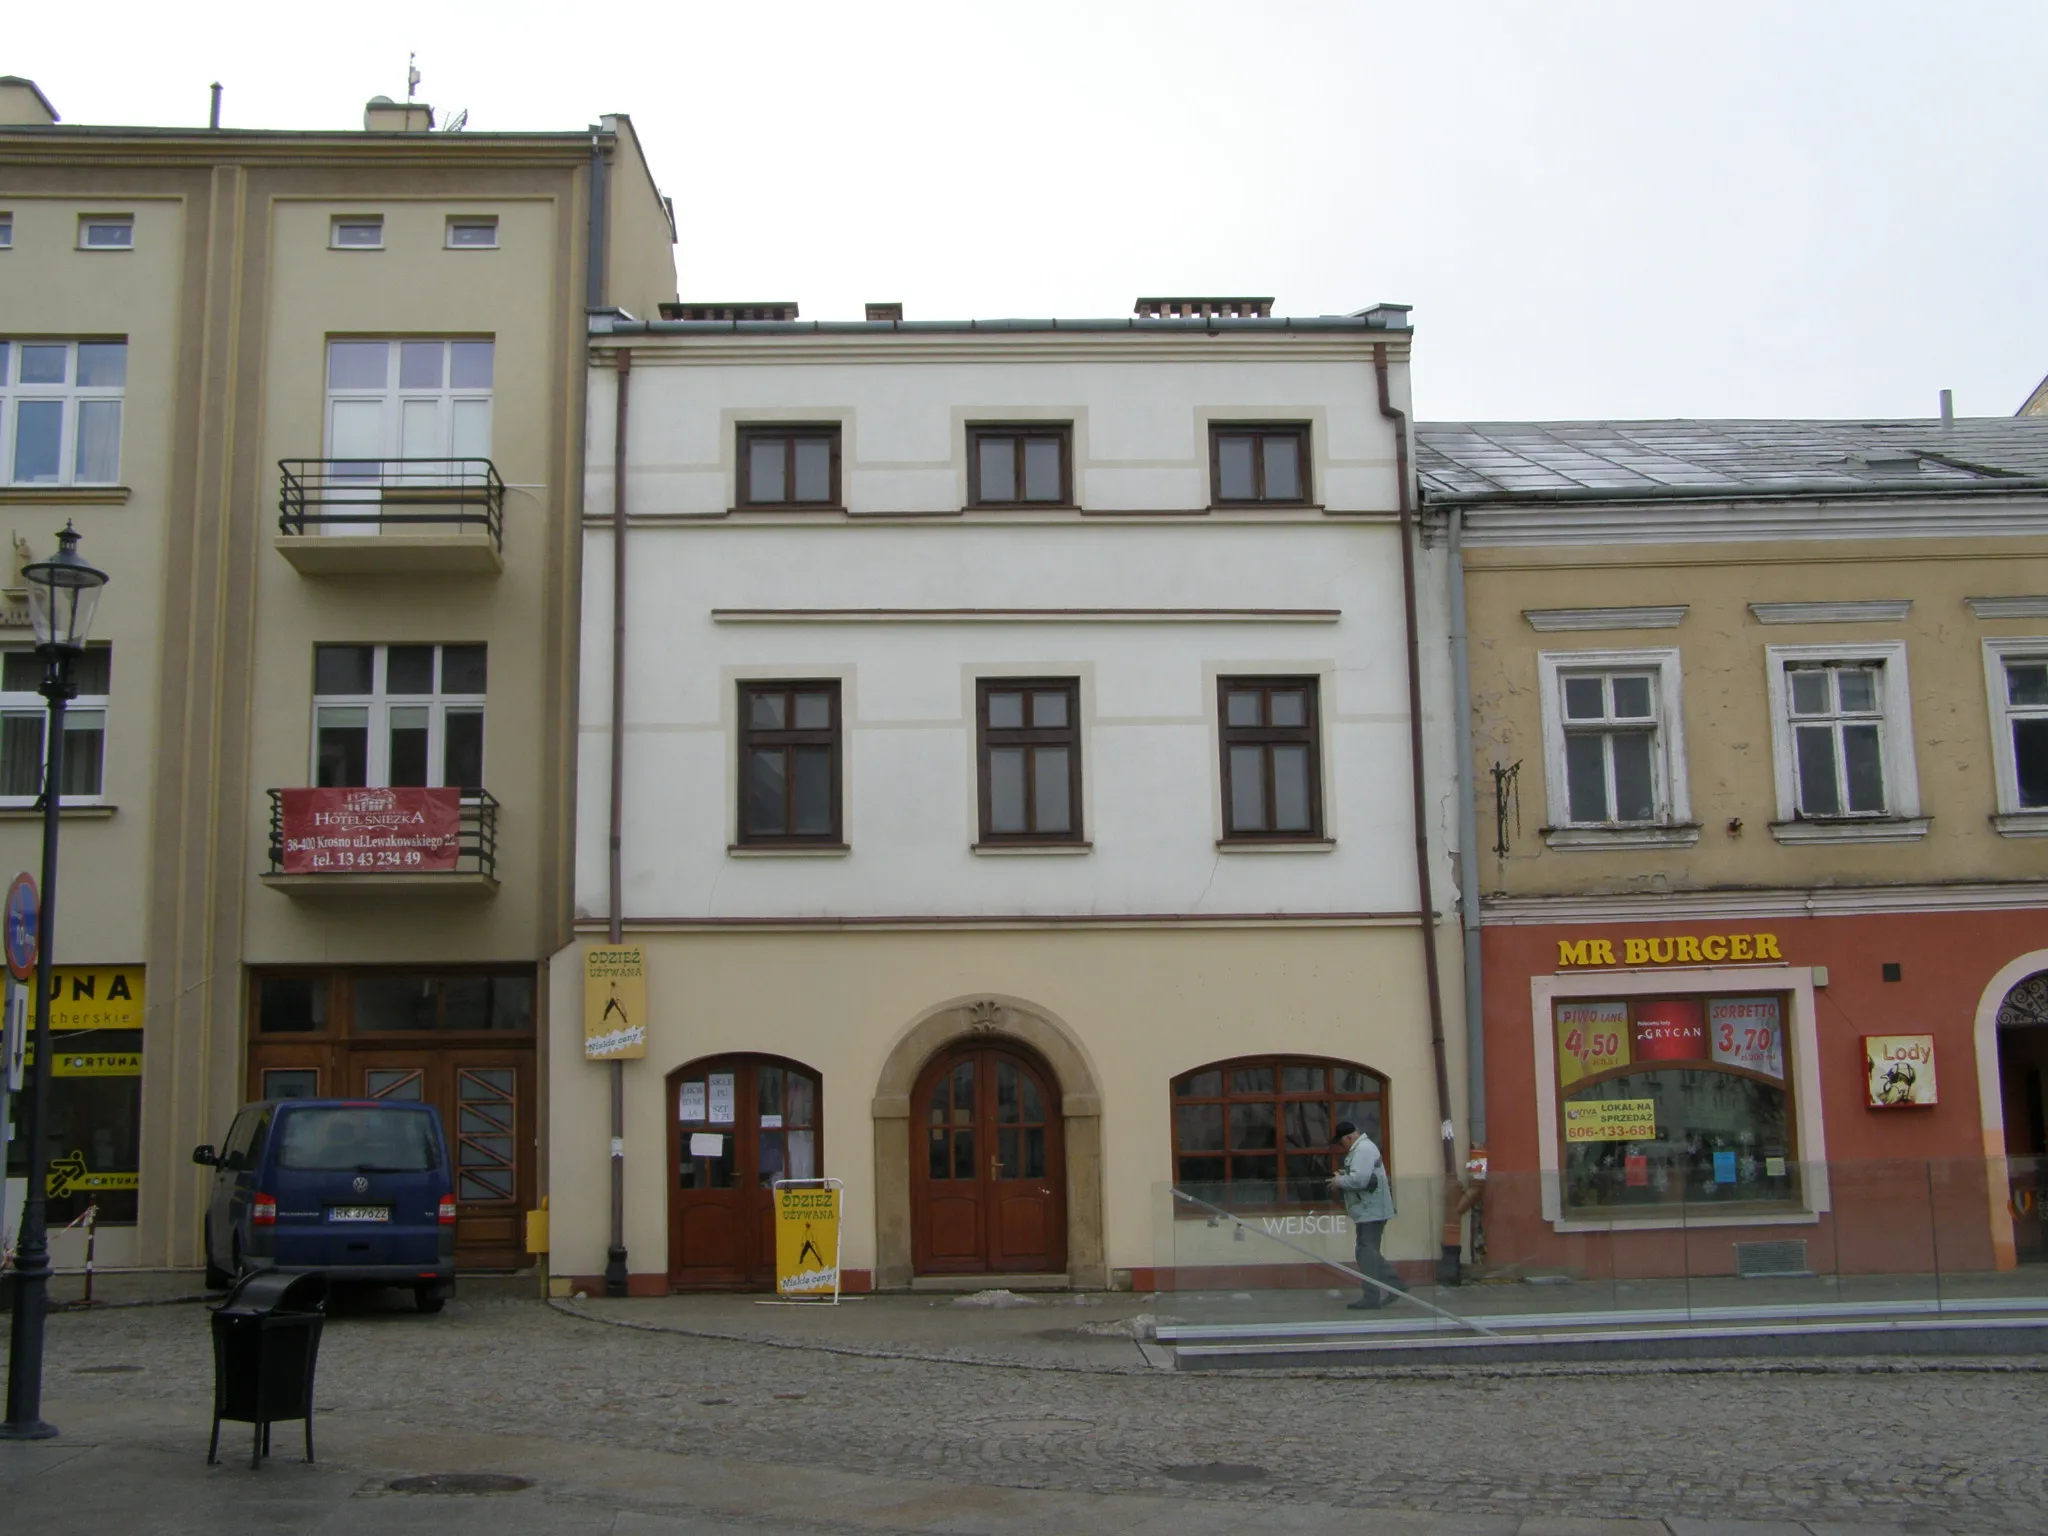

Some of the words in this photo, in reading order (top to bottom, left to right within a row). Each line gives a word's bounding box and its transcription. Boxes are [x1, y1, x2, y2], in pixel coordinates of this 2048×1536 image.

[314, 812, 360, 826] HOTEL
[287, 837, 315, 852] 38-400
[317, 836, 351, 849] Krosno
[313, 854, 334, 867] tel.
[338, 852, 354, 866] 13
[357, 852, 374, 866] 43
[377, 852, 401, 866] 234
[404, 852, 421, 865] 49
[1557, 939, 1617, 966] MR
[1623, 933, 1783, 965] BURGER
[1563, 1010, 1598, 1024] PIWO
[1713, 1003, 1776, 1020] SORBETTO
[1637, 1027, 1701, 1039] GRYCAN
[1718, 1022, 1771, 1057] 3,70
[1565, 1028, 1619, 1062] 4,50
[63, 1056, 139, 1067] FORTUNA
[1883, 1043, 1931, 1065] Lody
[1601, 1103, 1634, 1112] LOKAL
[1637, 1103, 1651, 1111] NA
[1568, 1125, 1654, 1138] 606-133-681
[84, 1175, 139, 1186] FORTUNA
[335, 1207, 350, 1218] RK
[1262, 1210, 1347, 1235] WEJŚCIE
[782, 1275, 810, 1288] Niskie
[811, 1272, 833, 1284] ceny
